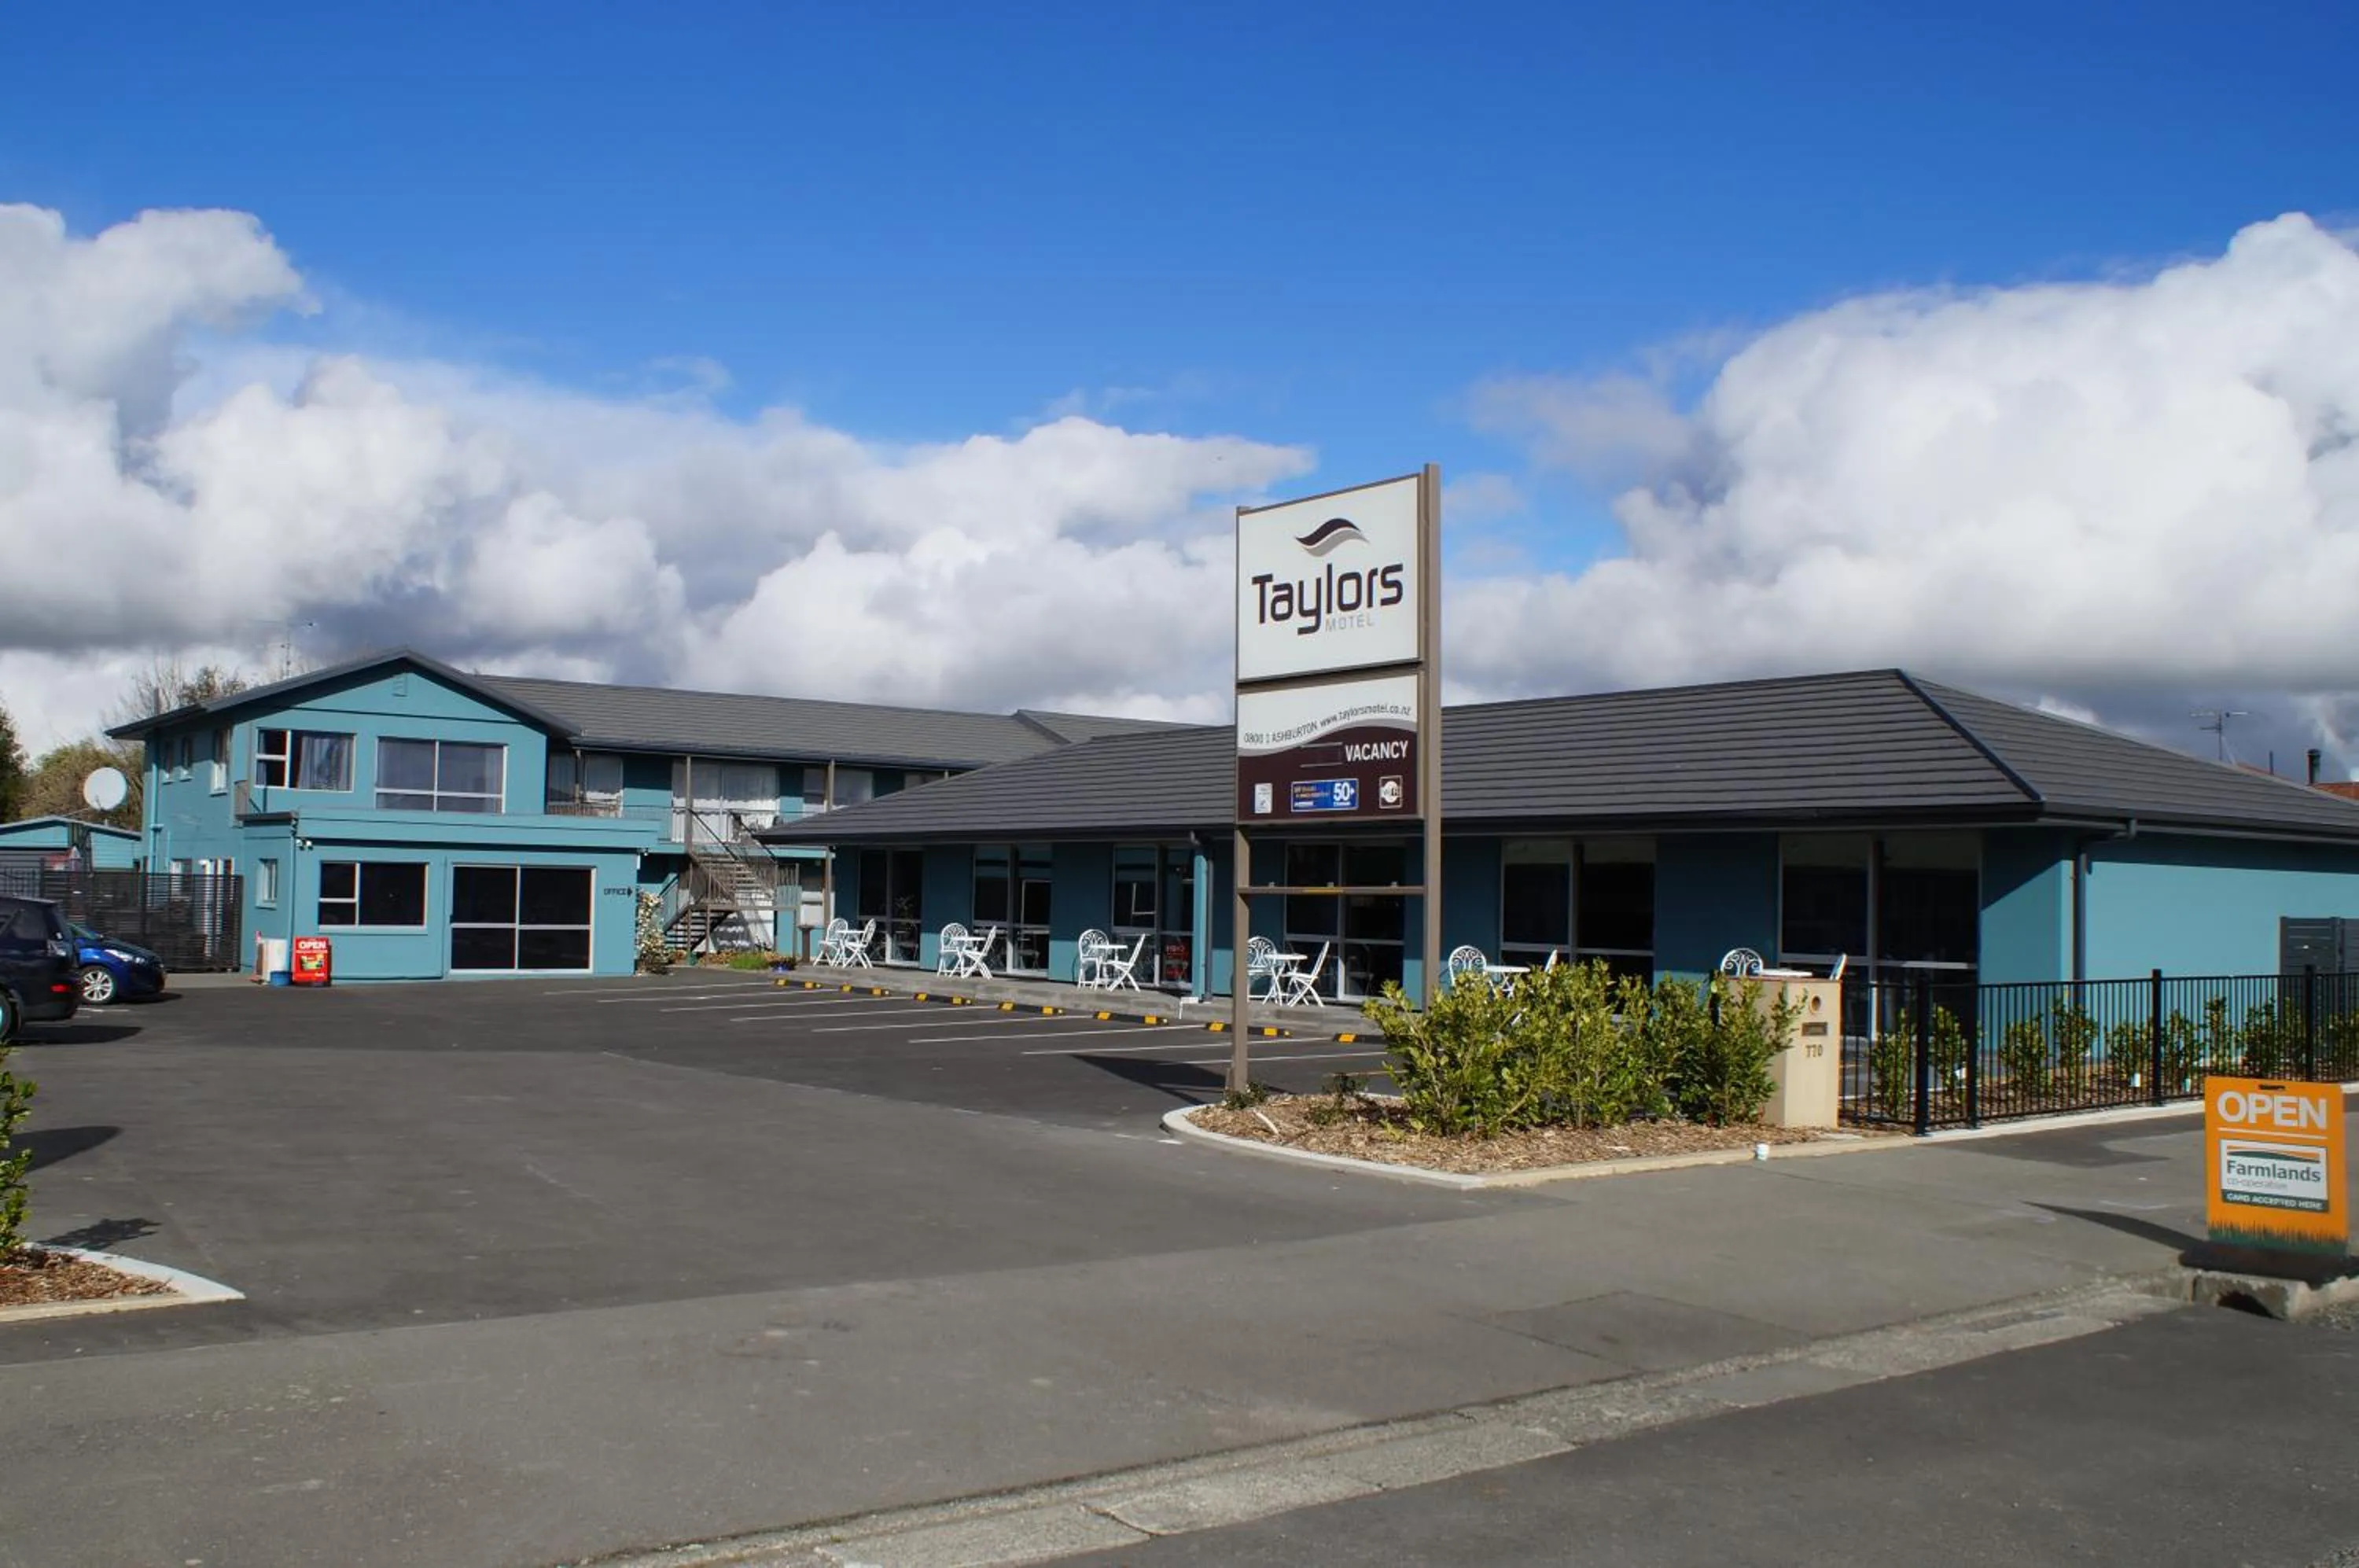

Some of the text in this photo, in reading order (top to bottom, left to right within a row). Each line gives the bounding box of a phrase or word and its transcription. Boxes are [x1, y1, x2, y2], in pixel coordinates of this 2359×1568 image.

[1251, 562, 1404, 636] Taylors
[1325, 613, 1375, 632] MOTEL
[1272, 720, 1318, 743] ASHBURTON
[1345, 740, 1408, 762] VACANCY
[1333, 782, 1350, 801] 50
[298, 940, 326, 949] OPEN
[2217, 1091, 2328, 1130] OPEN
[2226, 1159, 2321, 1182] Farmlands
[2251, 1195, 2296, 1208] ACCEPTED
[2298, 1200, 2323, 1210] HERE
